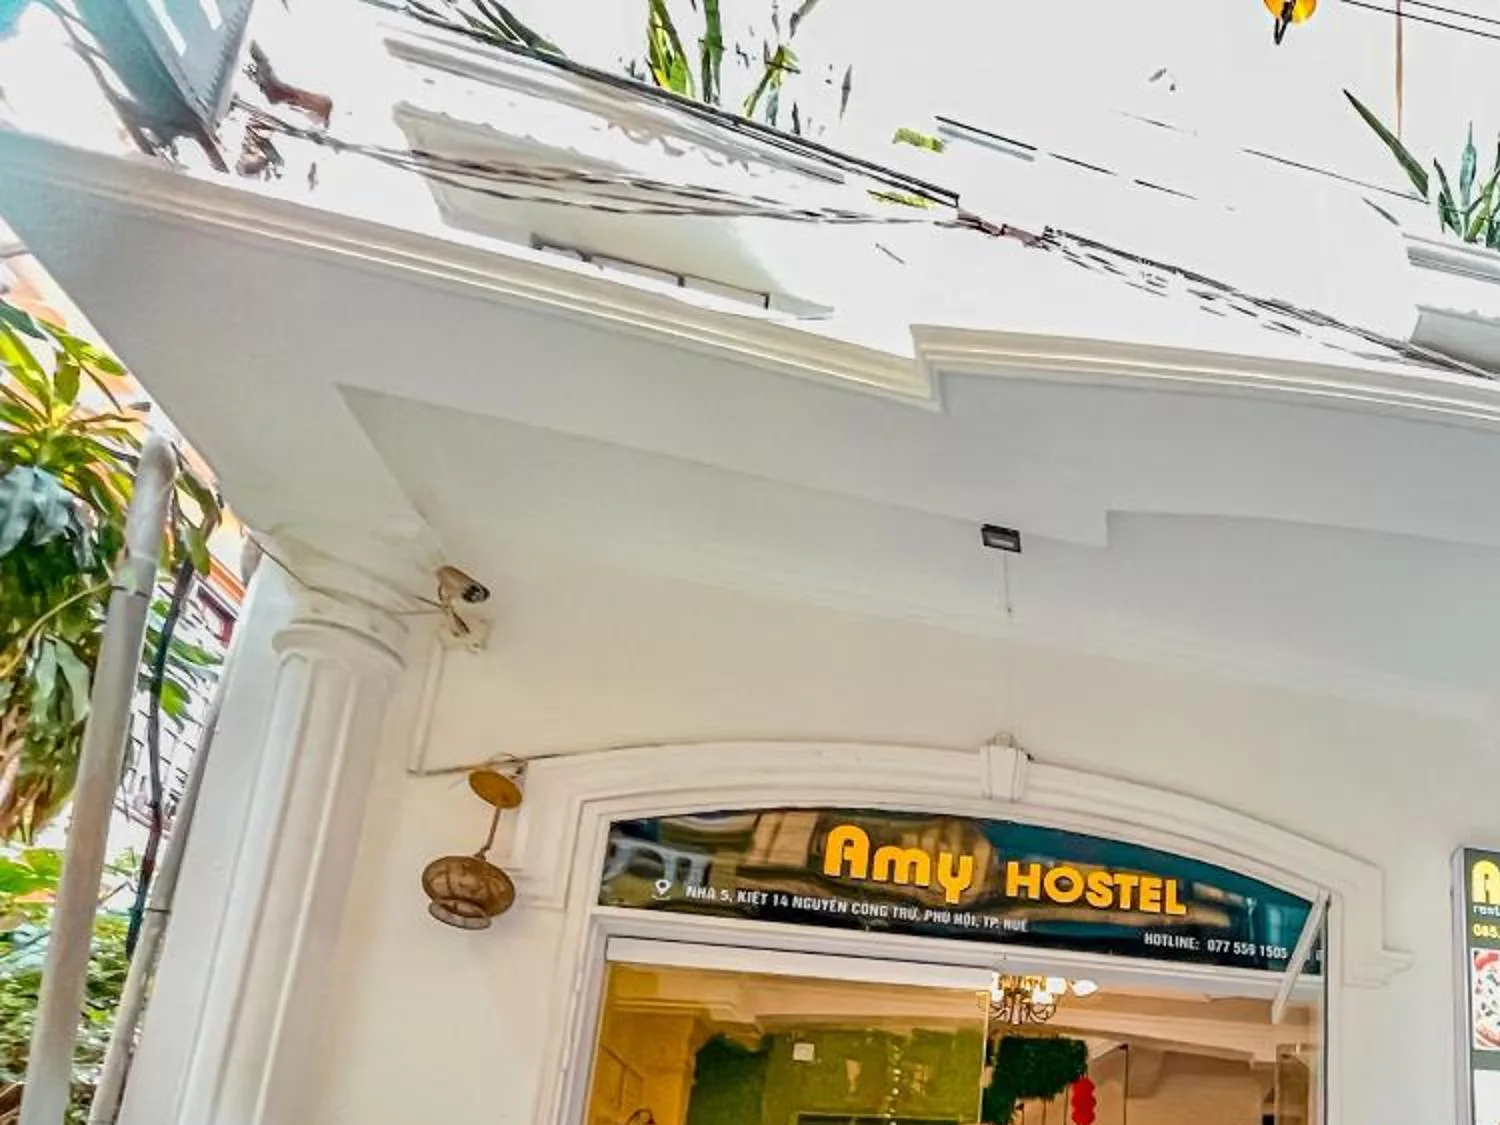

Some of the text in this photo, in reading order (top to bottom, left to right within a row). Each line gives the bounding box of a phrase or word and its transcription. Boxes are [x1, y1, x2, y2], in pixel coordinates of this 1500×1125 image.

[824, 825, 1187, 915] Amy HOSTEL
[773, 893, 789, 909] 14
[1144, 932, 1200, 950] HOTLINE:
[1207, 938, 1231, 954] 077
